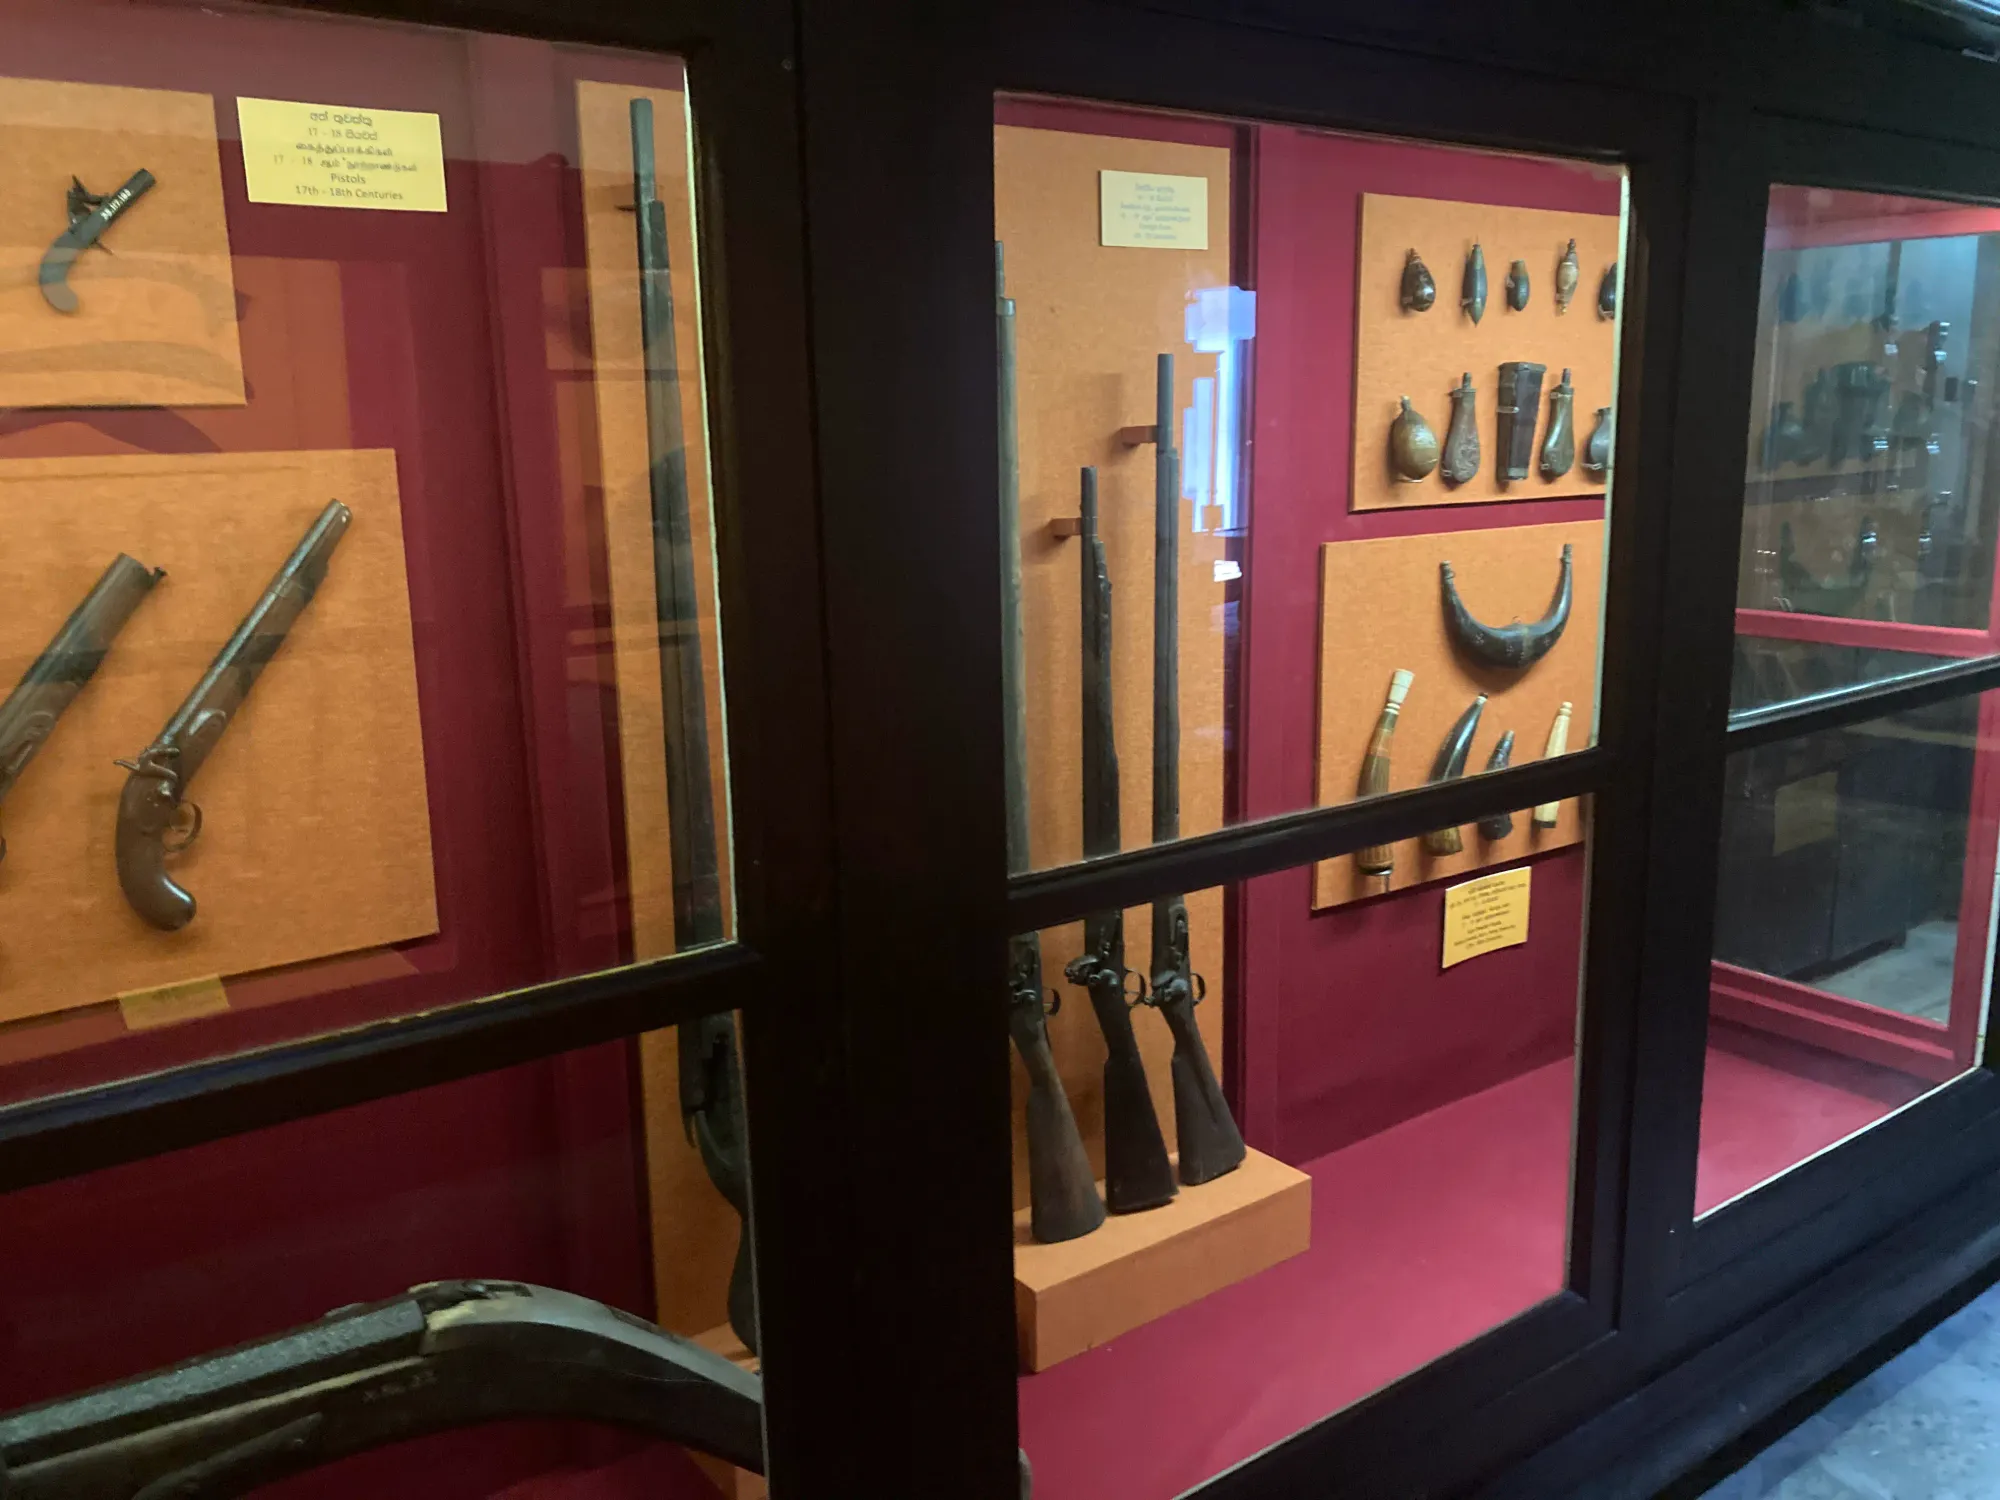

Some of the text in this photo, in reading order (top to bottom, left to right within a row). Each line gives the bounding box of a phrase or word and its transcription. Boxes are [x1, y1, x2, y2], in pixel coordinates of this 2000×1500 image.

[308, 127, 318, 137] 17
[331, 129, 342, 138] 18
[273, 154, 284, 165] 17
[302, 156, 313, 166] 18
[330, 172, 366, 185] Pistols
[295, 185, 319, 196] 17th
[329, 187, 353, 198] 18th
[354, 188, 404, 201] Centuries
